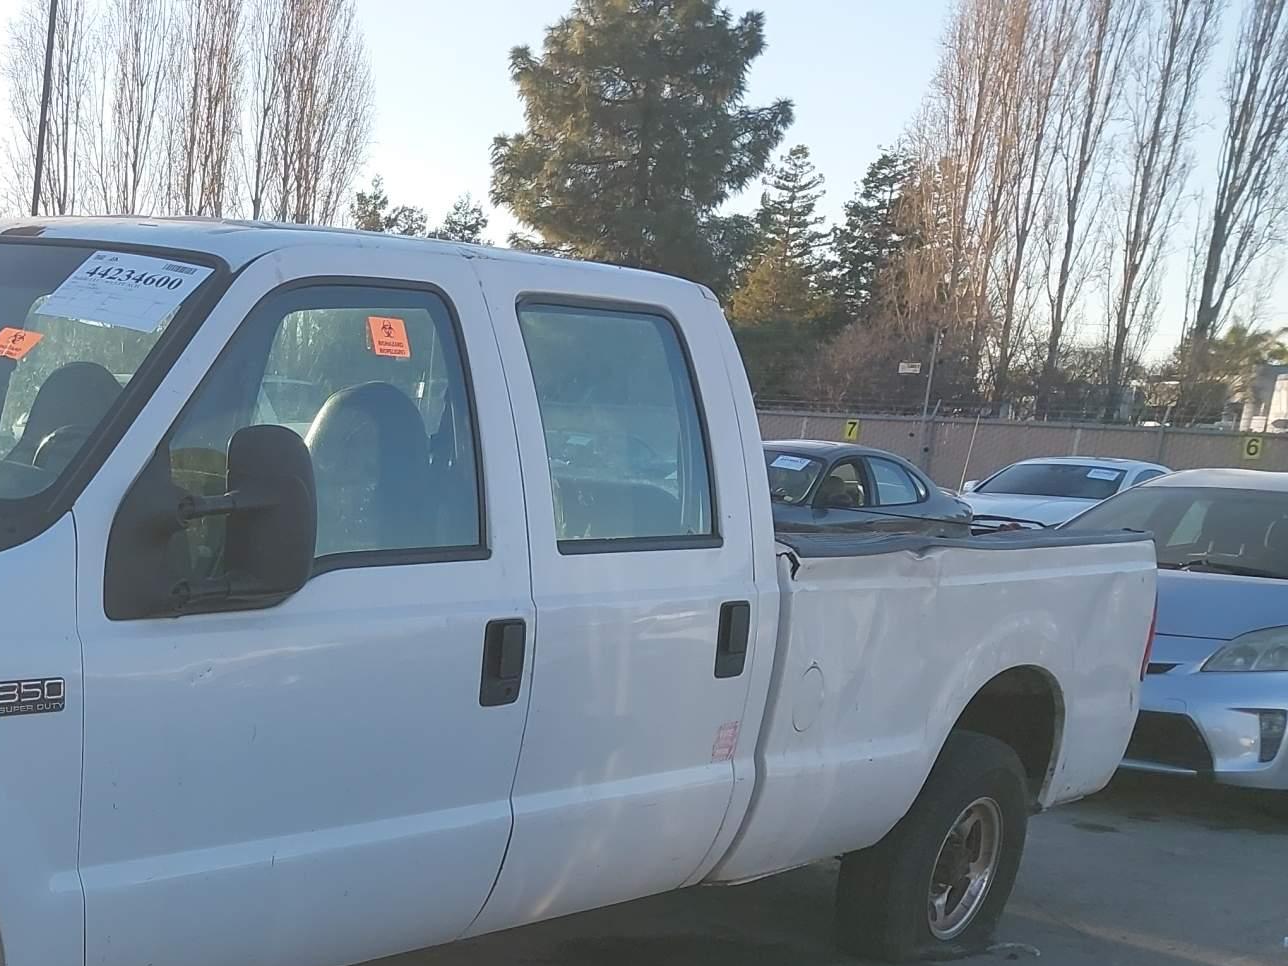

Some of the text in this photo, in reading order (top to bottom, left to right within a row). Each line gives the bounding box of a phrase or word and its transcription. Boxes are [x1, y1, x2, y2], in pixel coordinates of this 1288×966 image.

[85, 265, 183, 290] 44234600
[847, 421, 857, 437] 7
[1246, 438, 1259, 456] 6
[37, 702, 64, 711] DUTY
